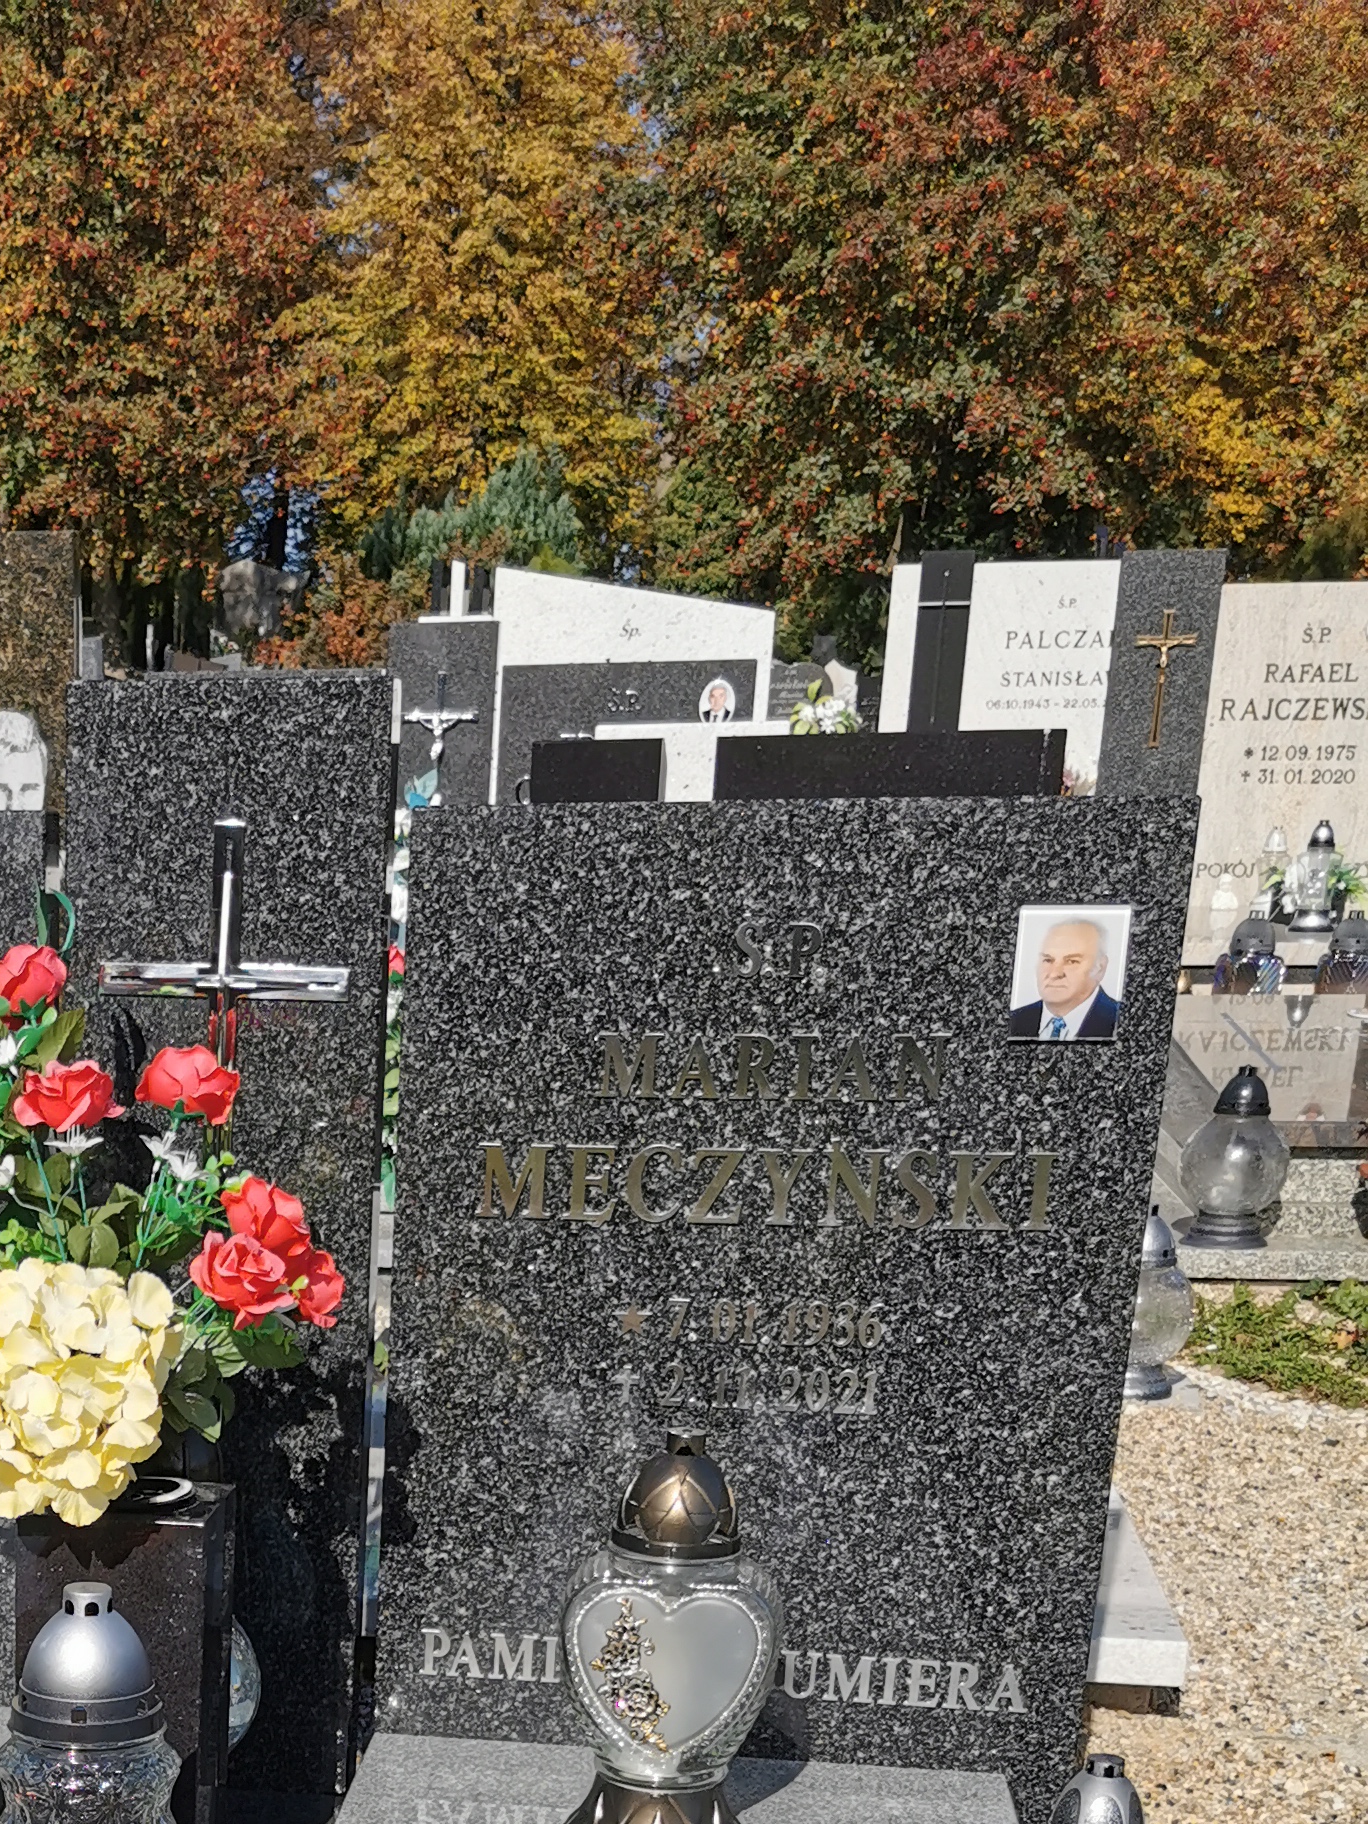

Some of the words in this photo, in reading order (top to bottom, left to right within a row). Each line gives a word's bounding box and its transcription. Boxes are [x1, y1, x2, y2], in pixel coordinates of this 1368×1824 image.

[1219, 697, 1368, 721] RAJCZEWS
[1195, 860, 1256, 879] POKÓJ
[594, 1032, 953, 1100] MARIAN
[419, 1627, 562, 1684] PAMI
[779, 1648, 1028, 1714] UMIERA
